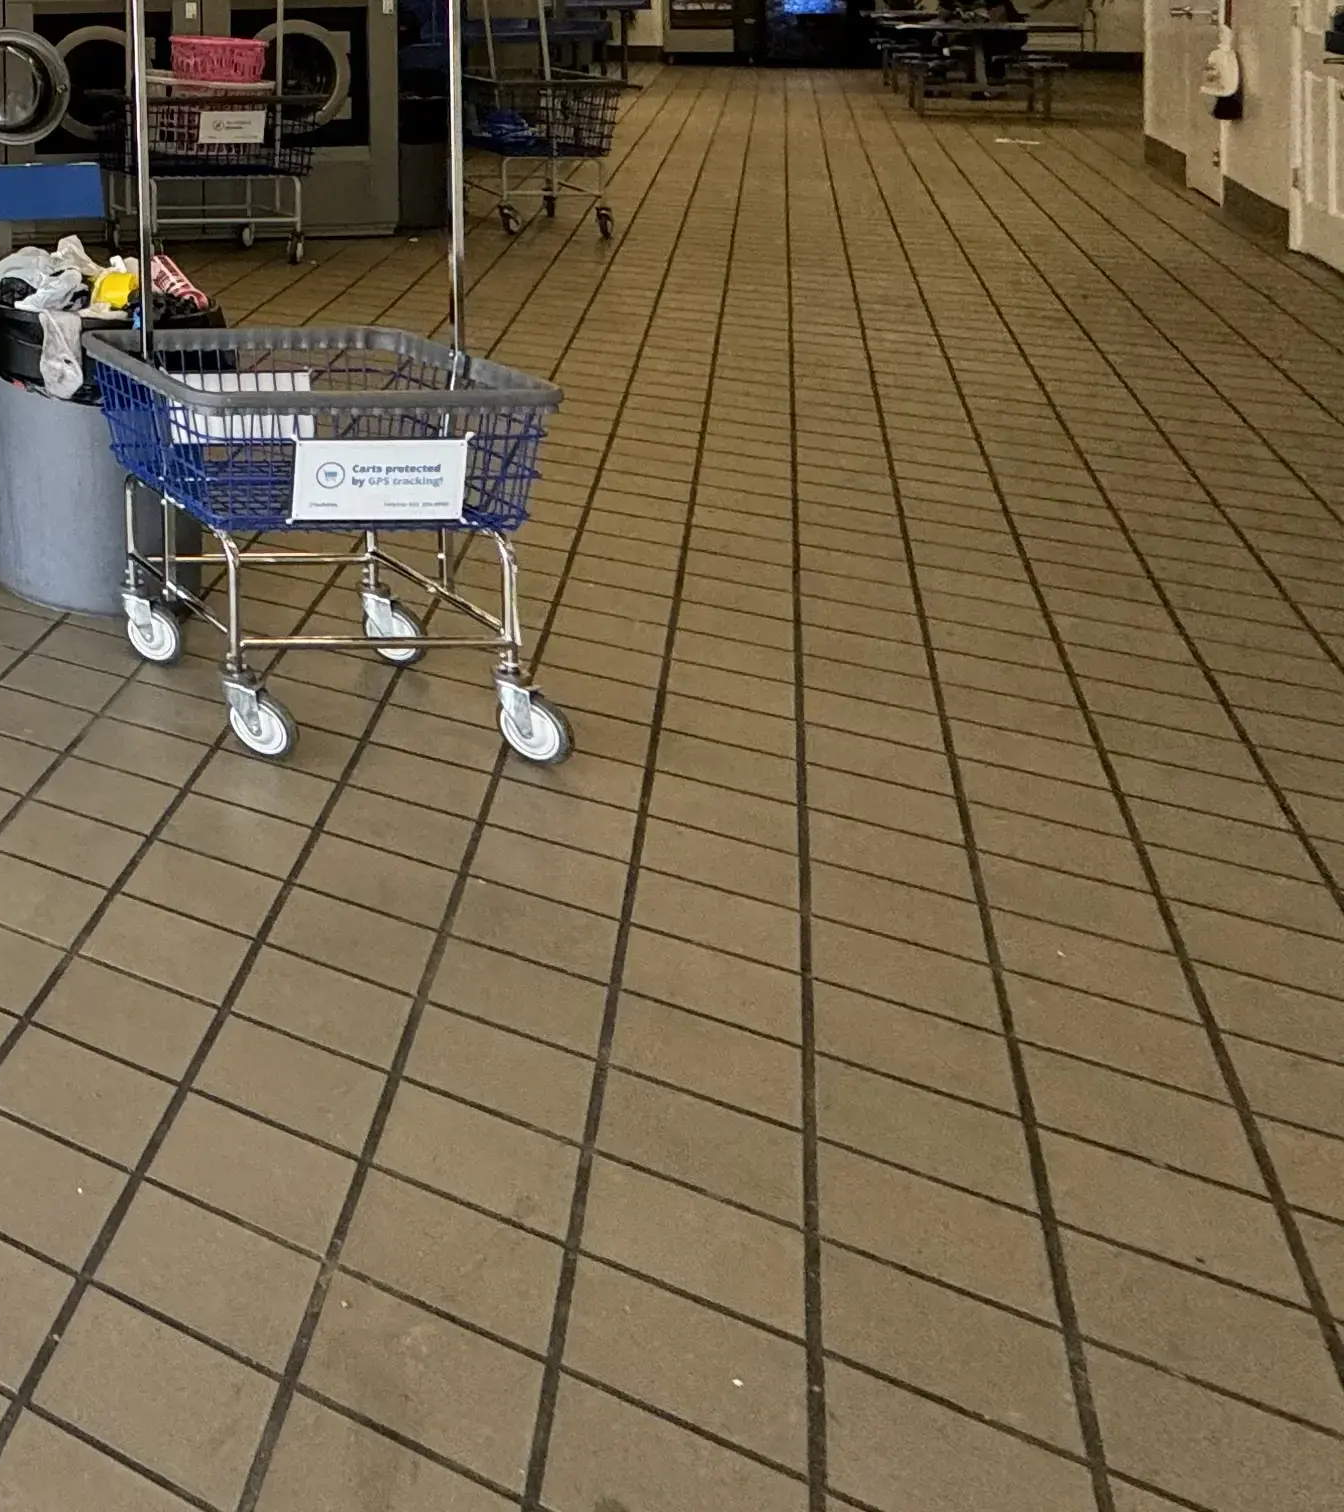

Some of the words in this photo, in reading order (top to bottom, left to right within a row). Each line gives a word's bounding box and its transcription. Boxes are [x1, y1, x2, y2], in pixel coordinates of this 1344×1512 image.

[352, 464, 382, 473] Carts
[385, 463, 441, 475] protected
[351, 477, 365, 488] by
[368, 477, 389, 486] GPS
[392, 476, 443, 488] tracking!
